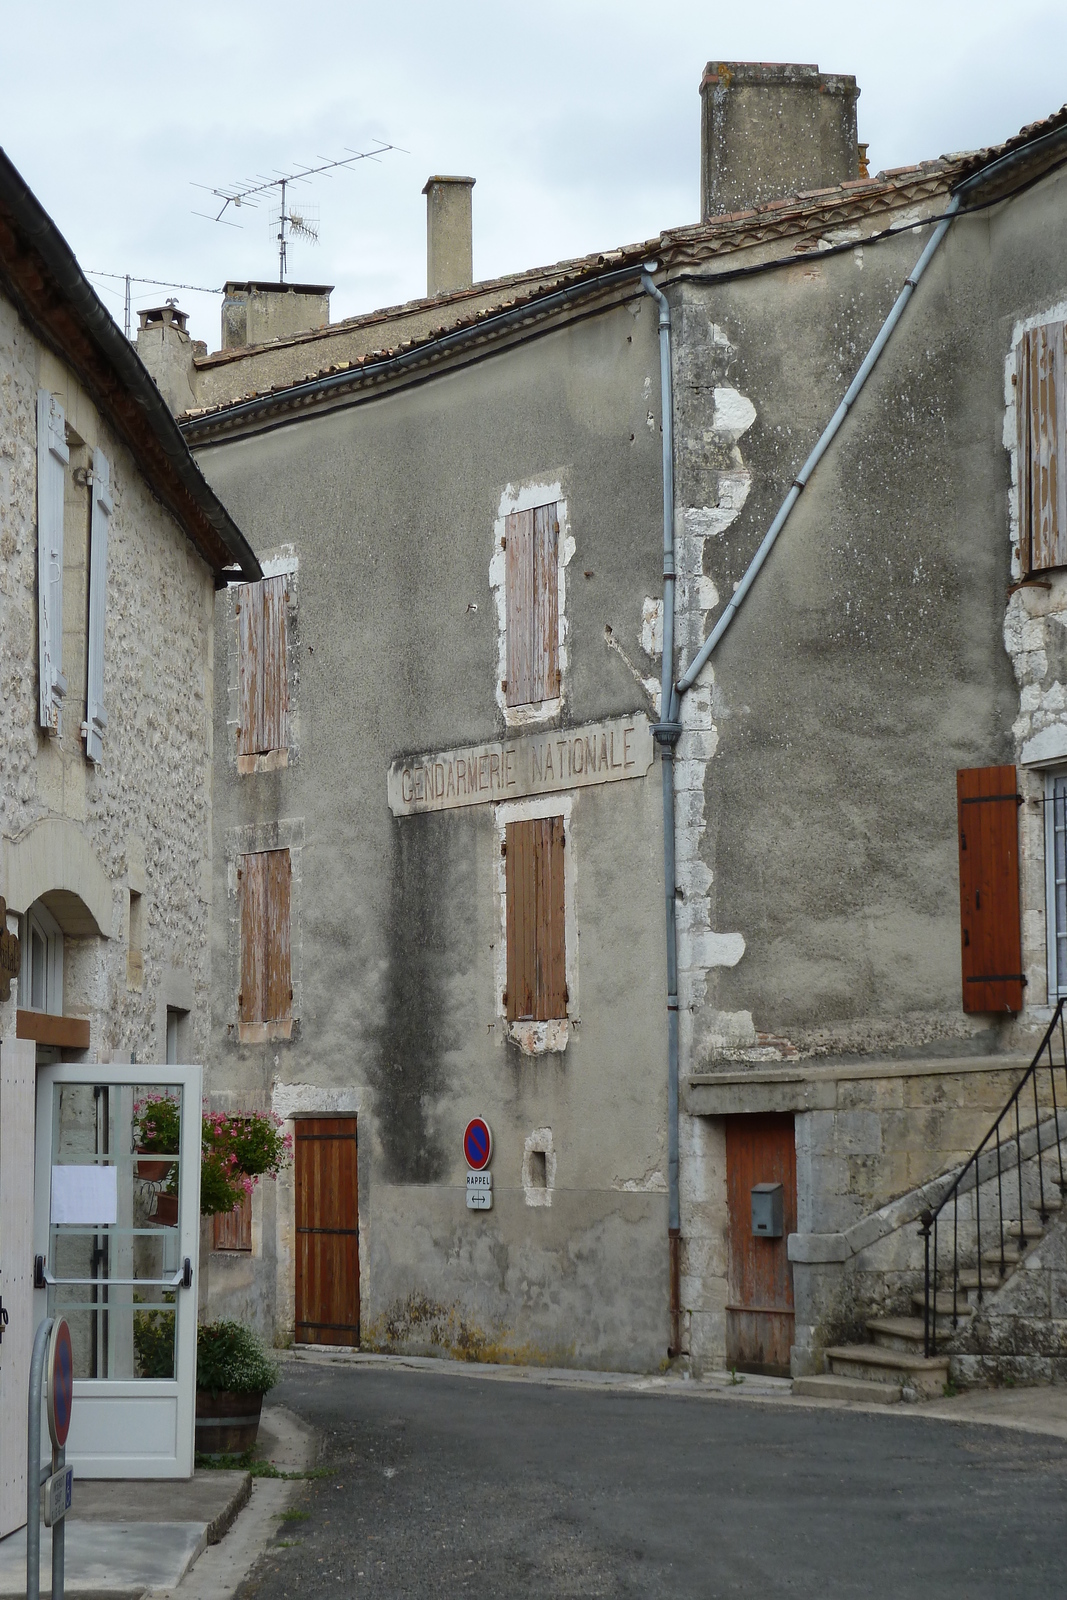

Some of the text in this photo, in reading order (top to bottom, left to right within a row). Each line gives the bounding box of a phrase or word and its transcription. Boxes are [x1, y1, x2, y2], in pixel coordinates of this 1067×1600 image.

[402, 727, 635, 804] GENDARMERIE NATIONALE
[467, 1177, 490, 1185] RAPPEL
